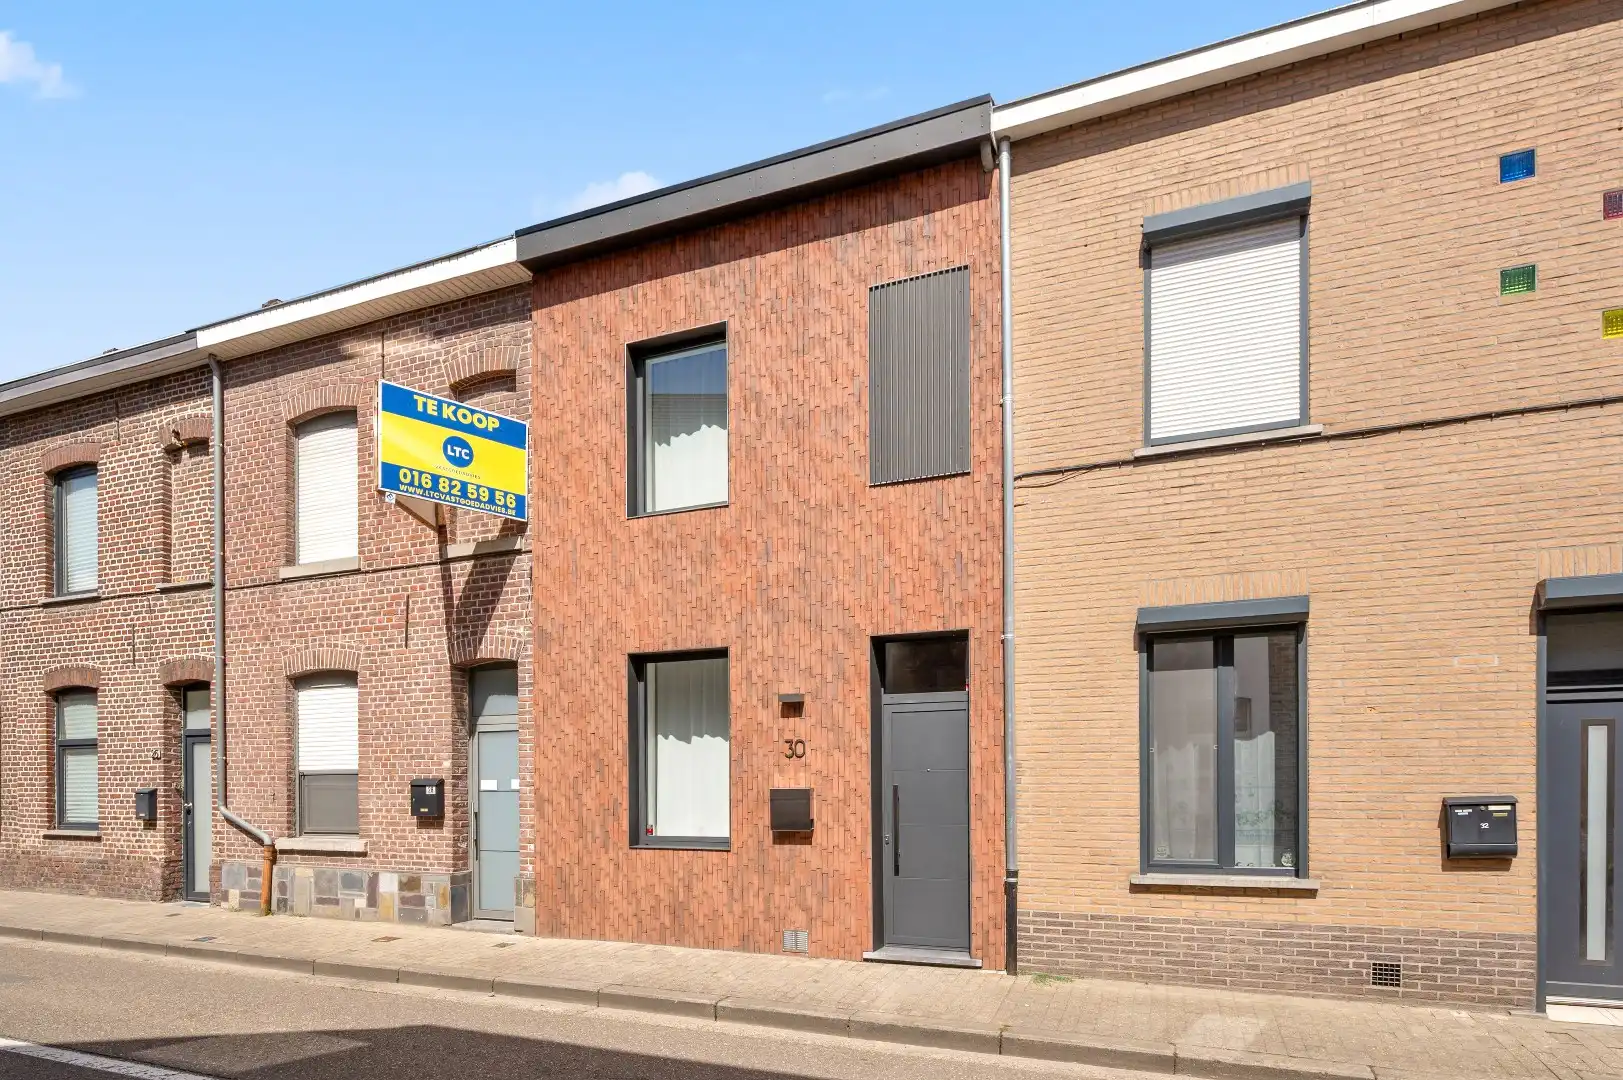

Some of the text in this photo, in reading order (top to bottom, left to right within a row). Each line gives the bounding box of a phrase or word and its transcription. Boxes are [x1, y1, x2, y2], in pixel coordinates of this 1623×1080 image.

[413, 394, 500, 432] TE KOOP
[447, 444, 470, 460] LTC
[398, 483, 516, 516] WWW.LTCVASTGOEDADVIES.BE
[399, 468, 433, 489] 016
[438, 477, 462, 496] 82
[467, 483, 489, 502] 59
[495, 490, 516, 509] 56
[784, 738, 806, 759] 30
